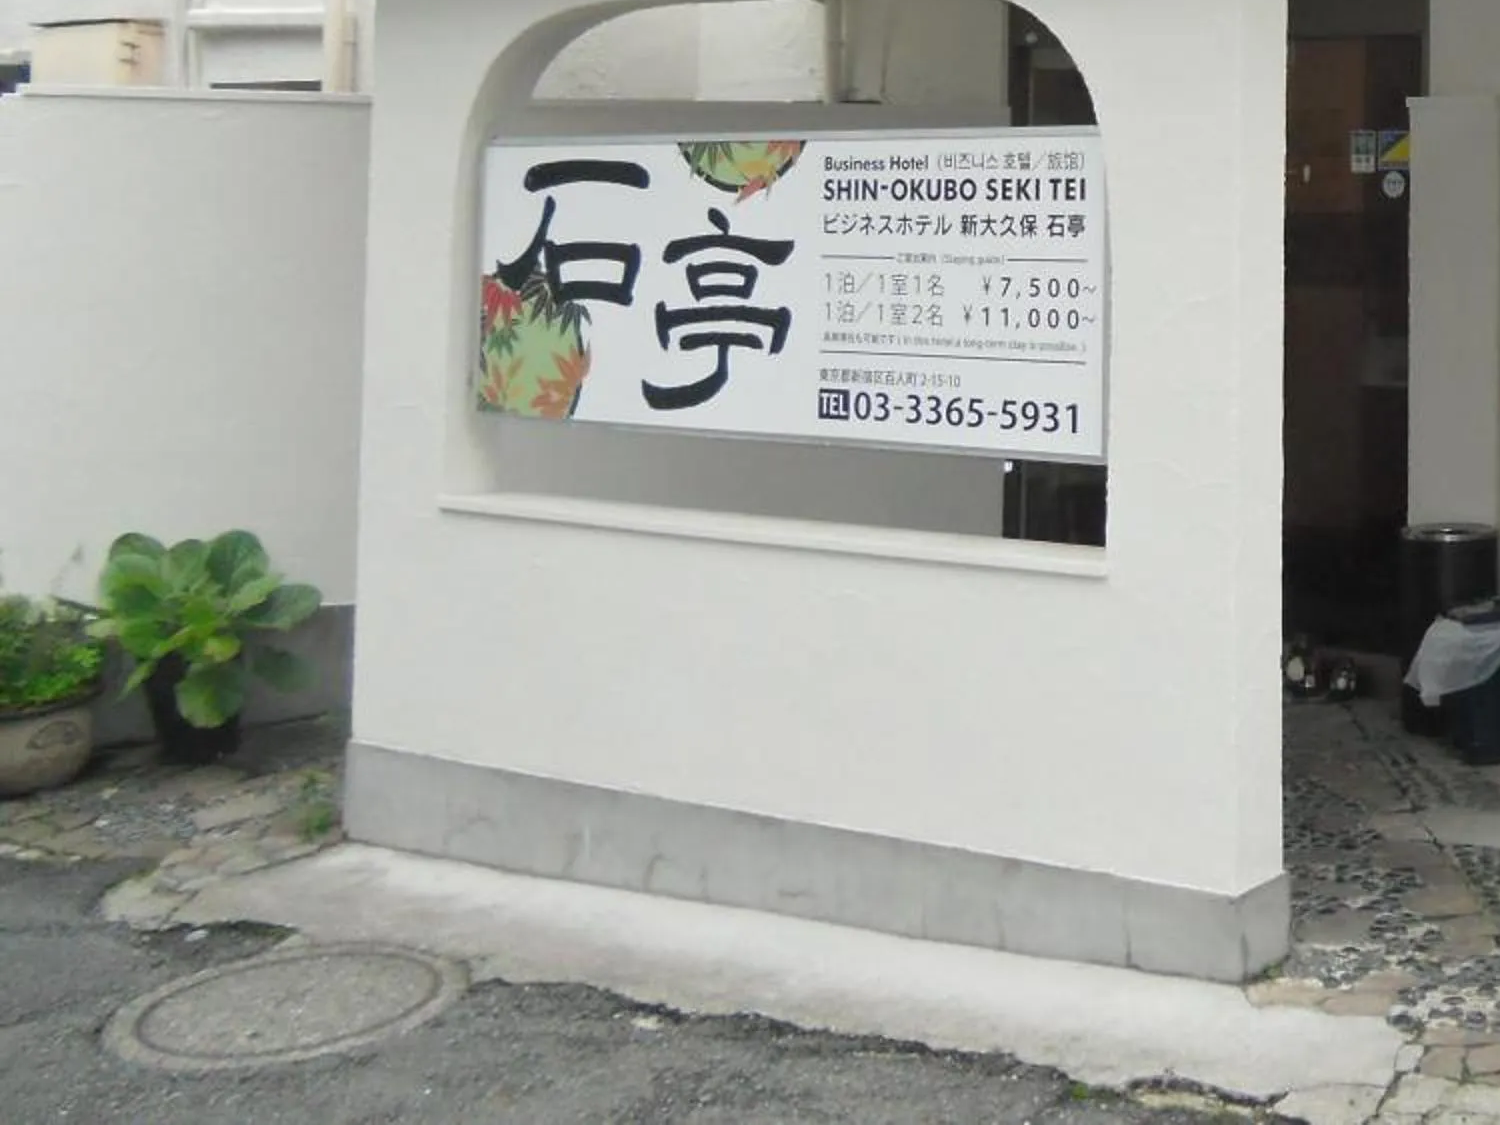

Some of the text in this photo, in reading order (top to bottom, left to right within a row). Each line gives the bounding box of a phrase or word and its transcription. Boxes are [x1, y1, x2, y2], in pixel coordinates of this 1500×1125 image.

[824, 156, 929, 171] Business Hotel
[824, 178, 1086, 202] SHIN-OKUBO SEKI TEI
[823, 214, 1086, 238] ビジネスホテル 新大久保 石亭
[492, 159, 795, 410] 石亭
[822, 391, 1080, 434] TEL 03-3365-5931
